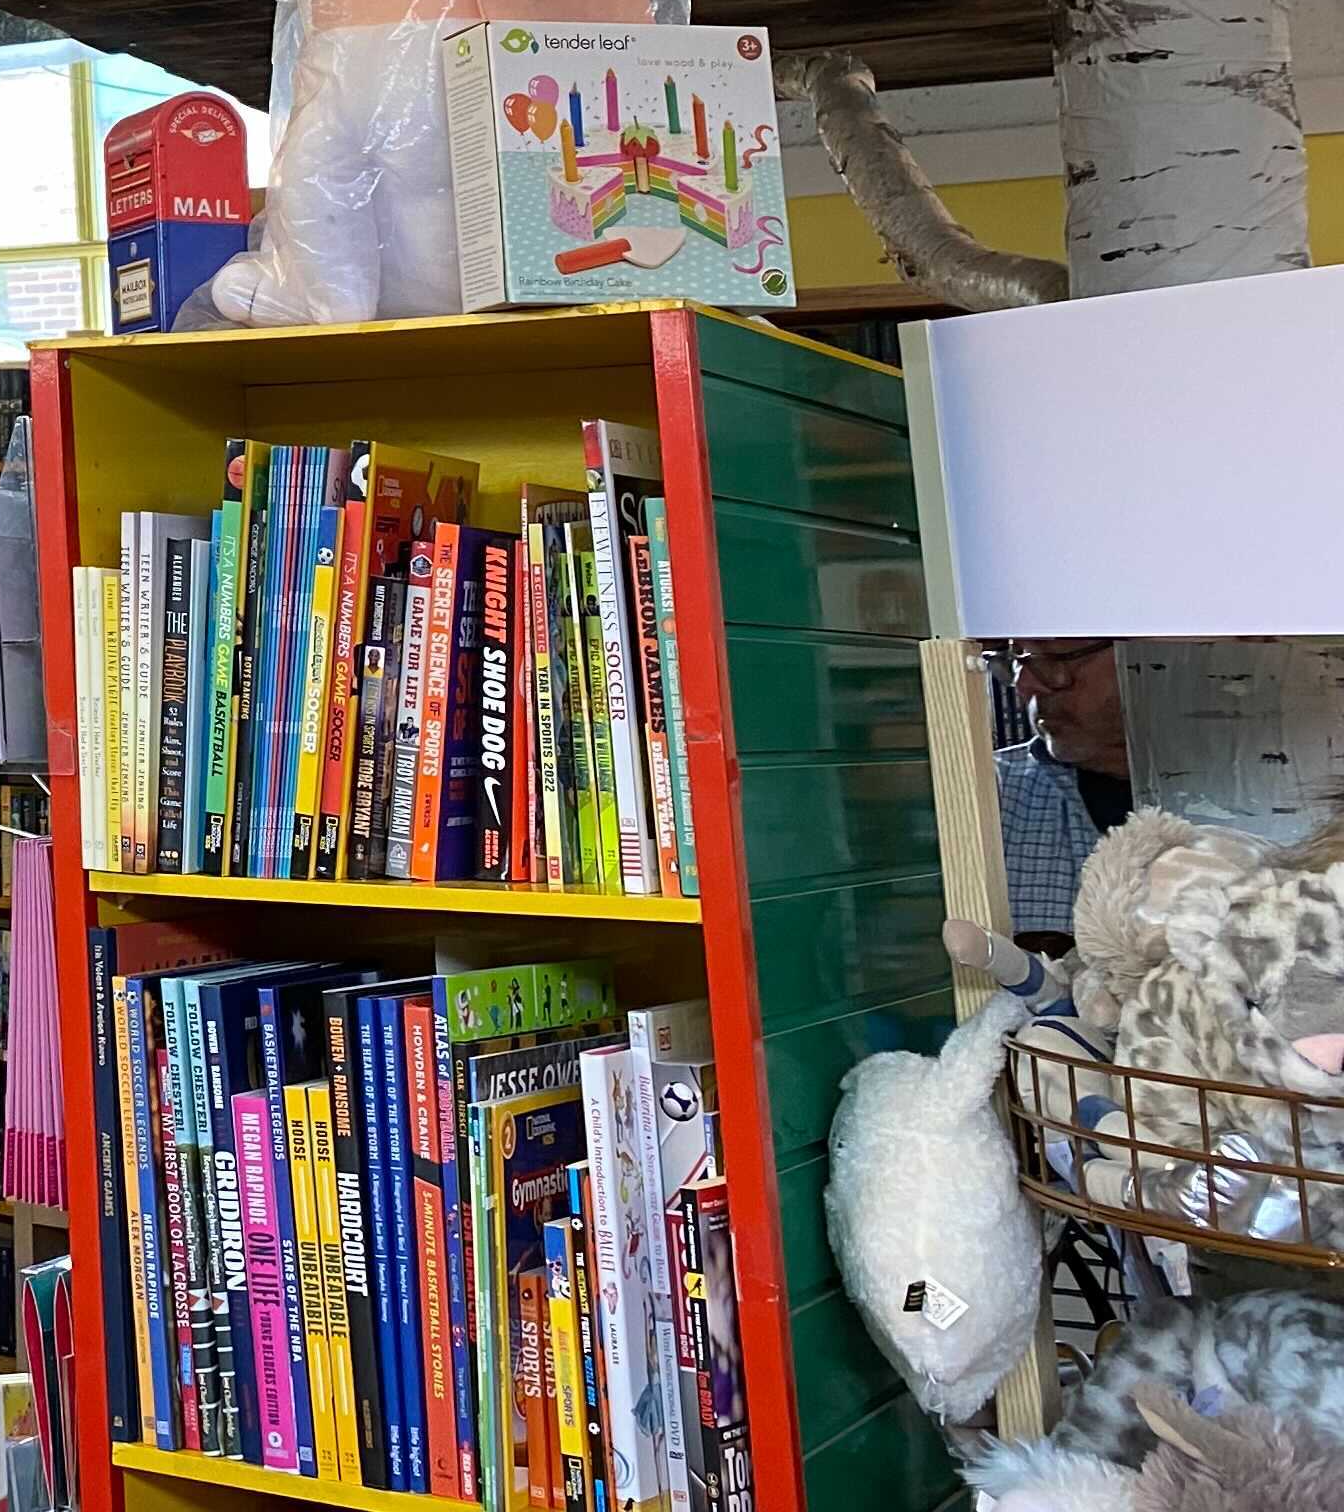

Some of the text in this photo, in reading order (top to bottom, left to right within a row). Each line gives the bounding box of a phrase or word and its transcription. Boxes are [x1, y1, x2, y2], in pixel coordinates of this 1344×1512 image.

[544, 33, 630, 50] tender leaf
[741, 39, 758, 53] 3+
[168, 105, 237, 137] SPECIAL DELIVERY
[110, 189, 154, 217] LETTERS
[174, 196, 240, 219] MAIL
[121, 279, 147, 294] MAILBOX
[519, 275, 562, 287] Rainbow
[606, 277, 633, 288] Cake
[170, 554, 183, 603] ALEXANDER
[483, 545, 508, 644] KNIGHT
[589, 496, 626, 722] EYEWITNESS SOCCER
[165, 610, 189, 636] THE
[404, 596, 425, 709] GAME FOR LIFE
[481, 647, 507, 772] SHOE DOG
[412, 1023, 431, 1161] HOWDEN & CRAINE
[638, 1074, 651, 1134] Ballerina
[213, 1150, 248, 1292] GRIDIRON
[241, 1111, 281, 1308] MEGAN RAPINOE ONE LIFE
[291, 1119, 325, 1338] HOOSE UNBEATABLE
[337, 1171, 369, 1297] HARDCOURT
[422, 1190, 444, 1401] 5-MINUTE BASKETBALL STORIES
[520, 1319, 542, 1399] SPORTS
